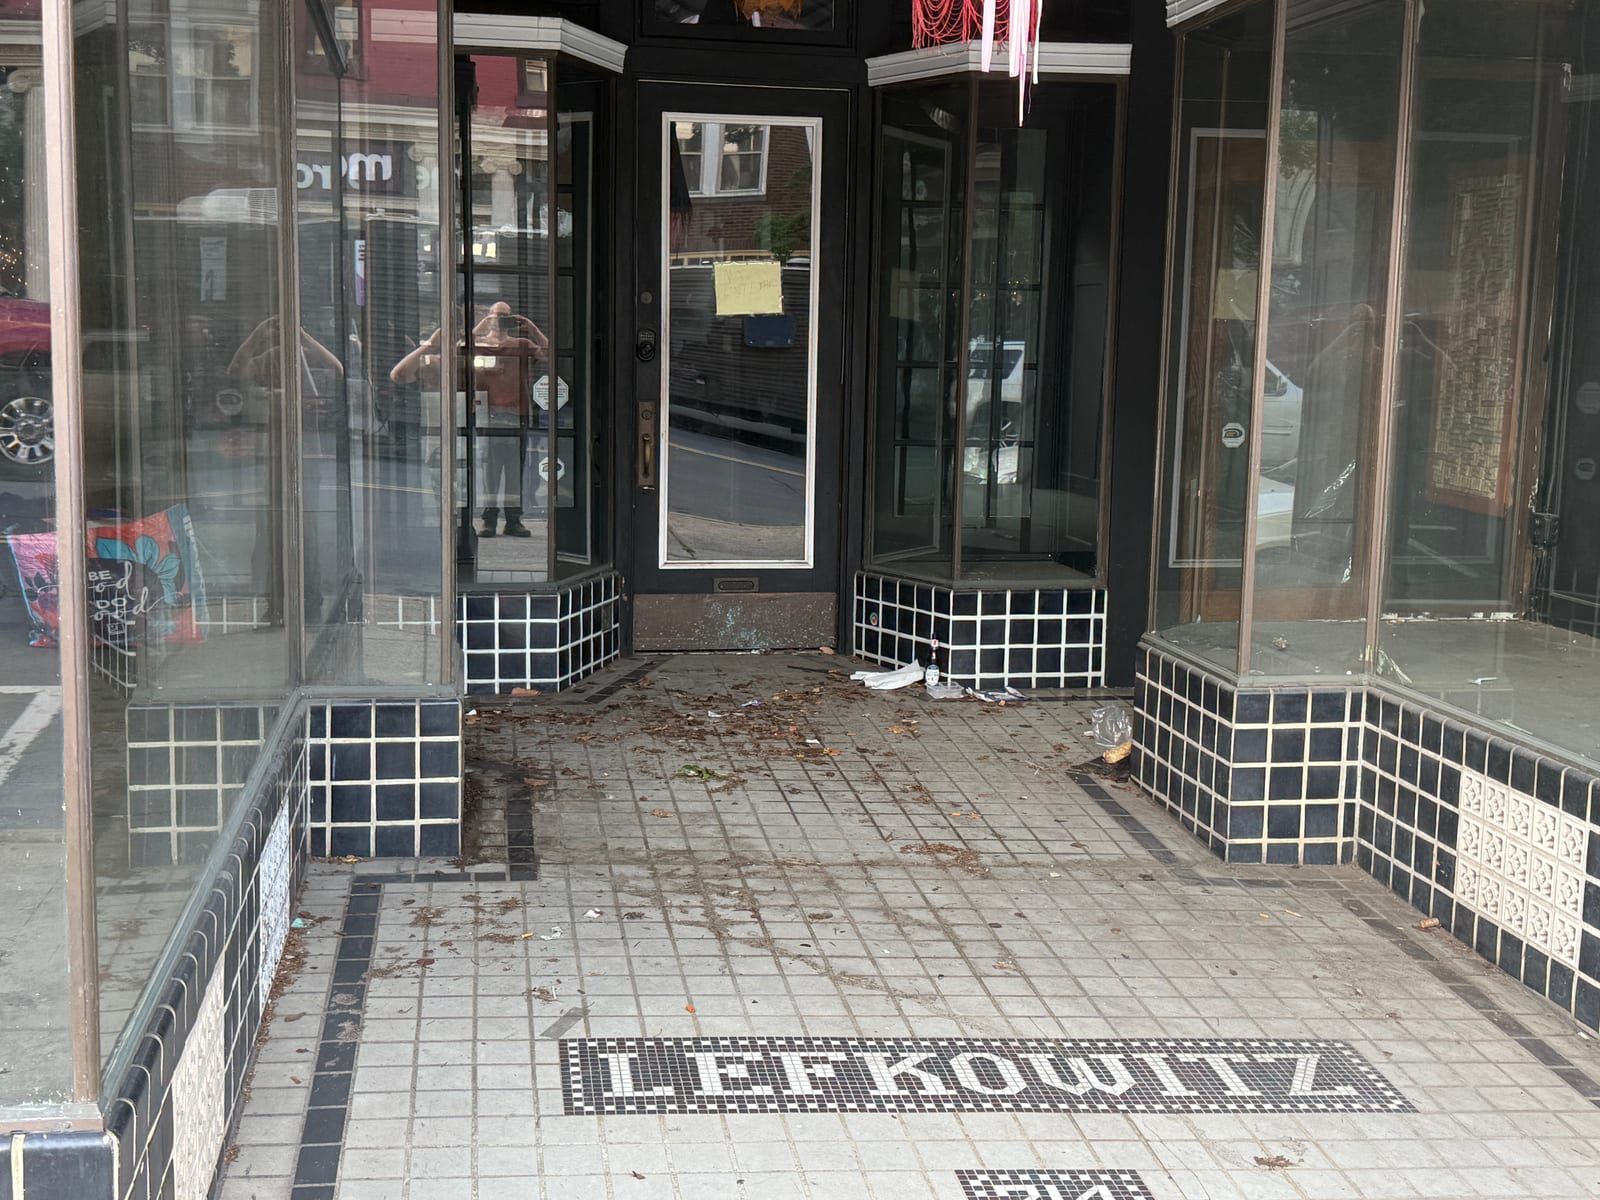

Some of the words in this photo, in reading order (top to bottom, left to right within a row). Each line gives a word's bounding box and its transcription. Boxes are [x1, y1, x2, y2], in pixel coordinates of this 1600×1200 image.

[88, 570, 112, 581] BE
[96, 597, 127, 609] DO
[600, 1051, 1359, 1098] LEFKOWITZ
